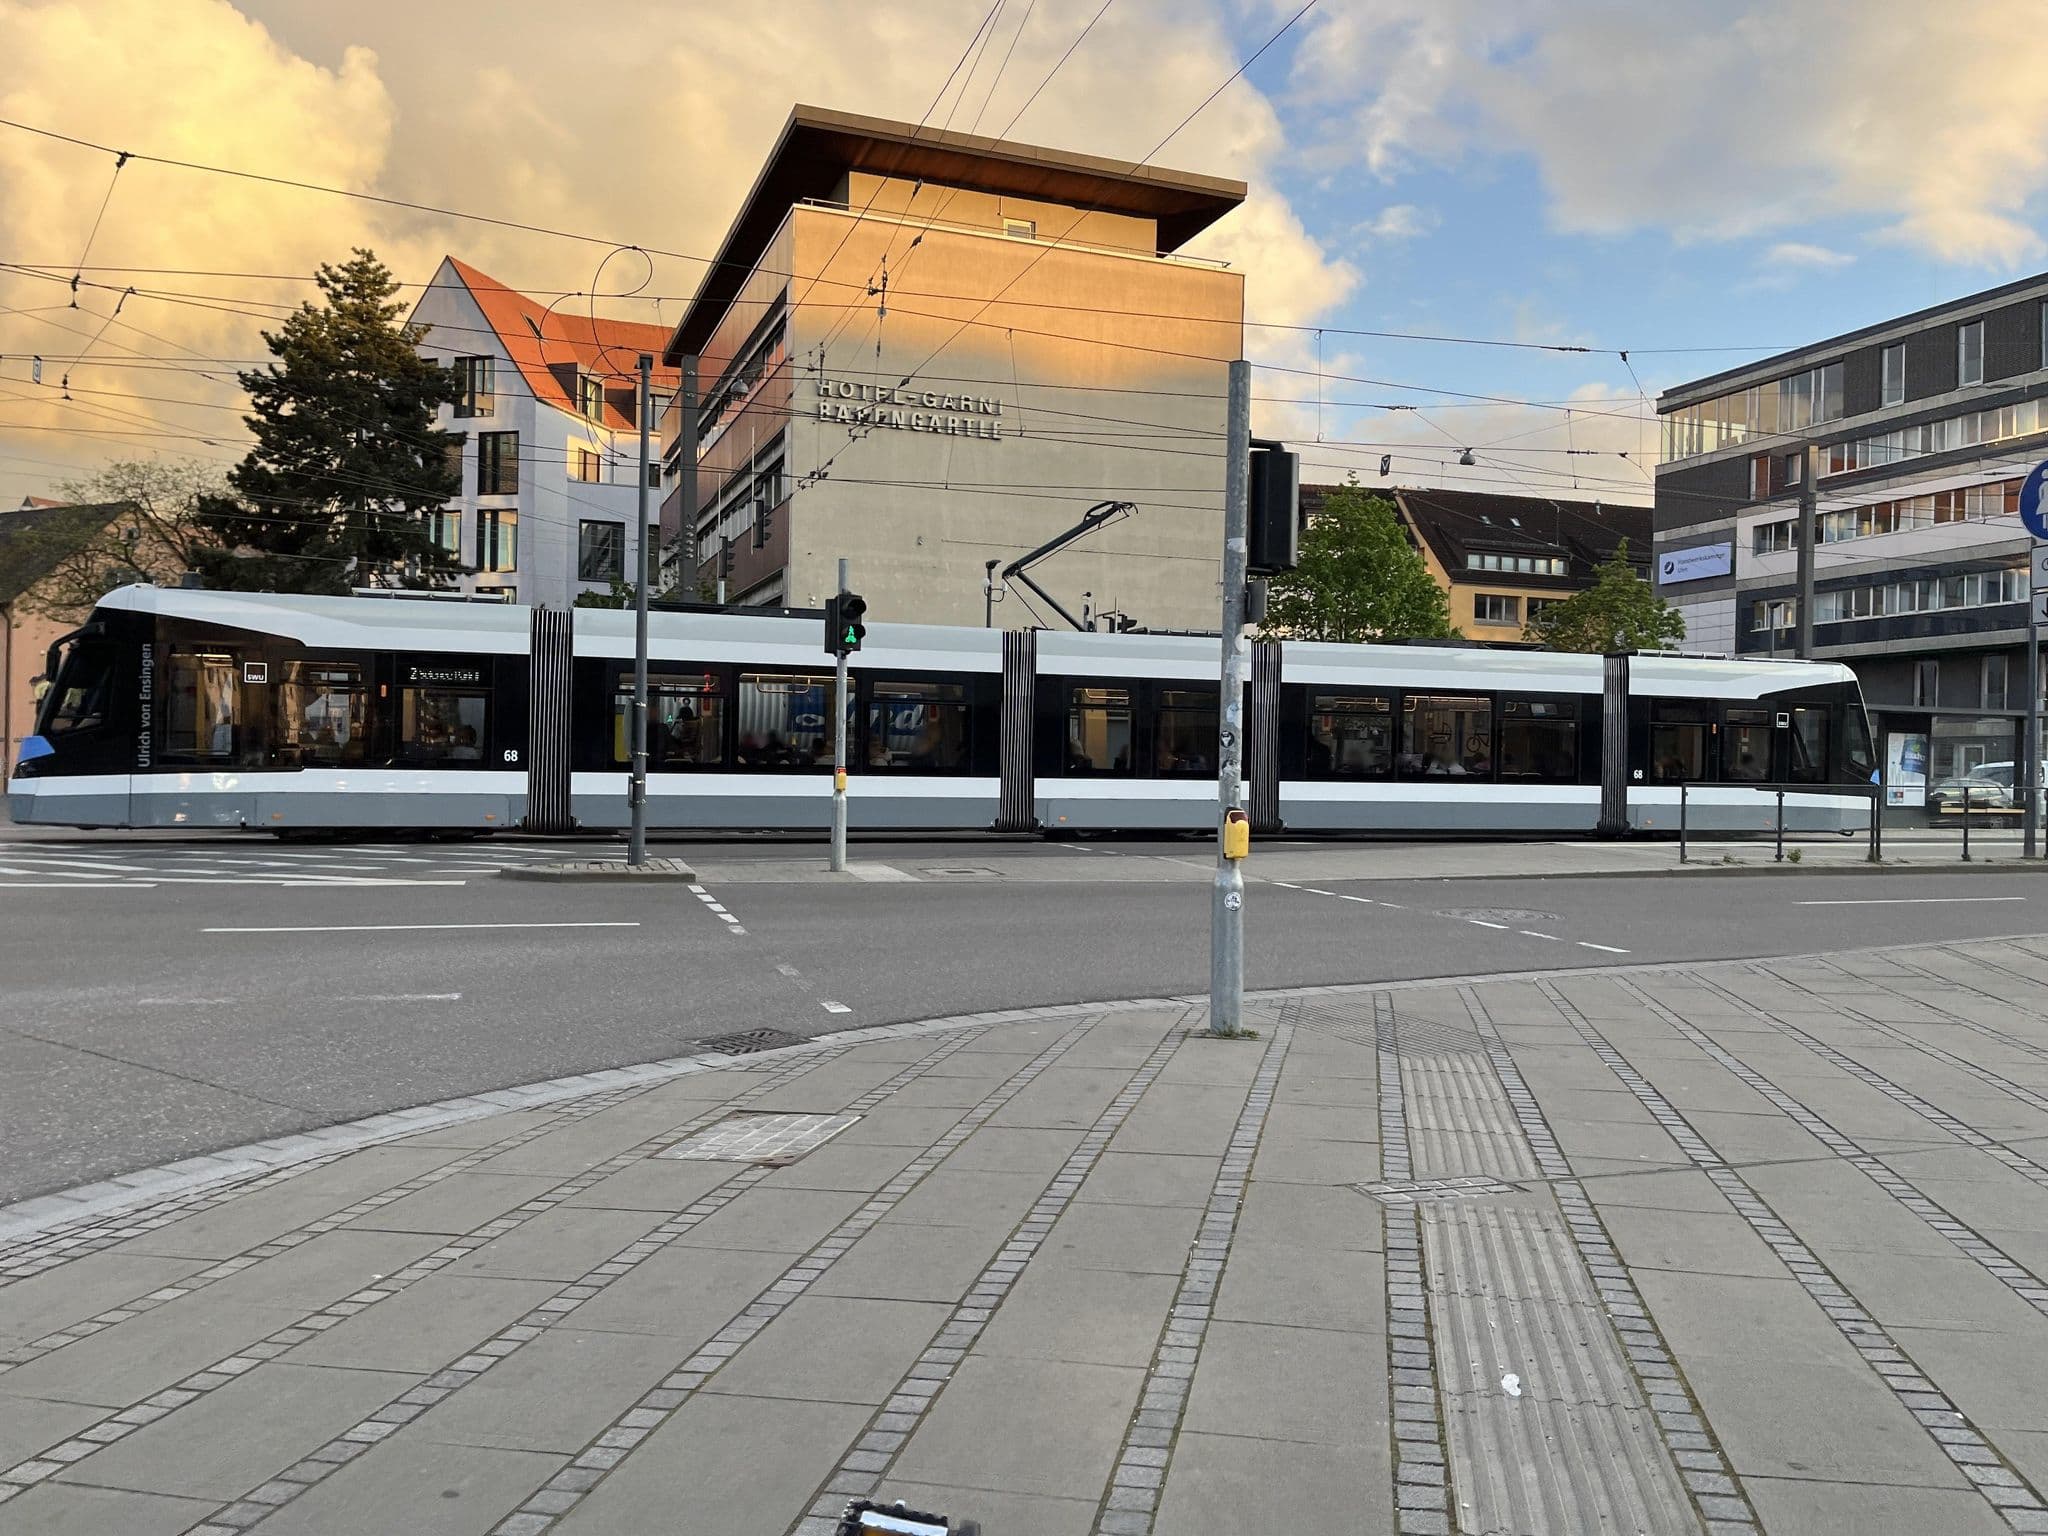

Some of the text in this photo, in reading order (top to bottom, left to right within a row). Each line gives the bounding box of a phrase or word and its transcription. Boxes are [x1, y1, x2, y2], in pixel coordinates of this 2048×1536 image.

[818, 380, 1004, 416] HOTEL-GARNI
[138, 643, 154, 768] Ulrich von Ensingen
[504, 750, 518, 761] 68
[1634, 769, 1643, 779] 68
